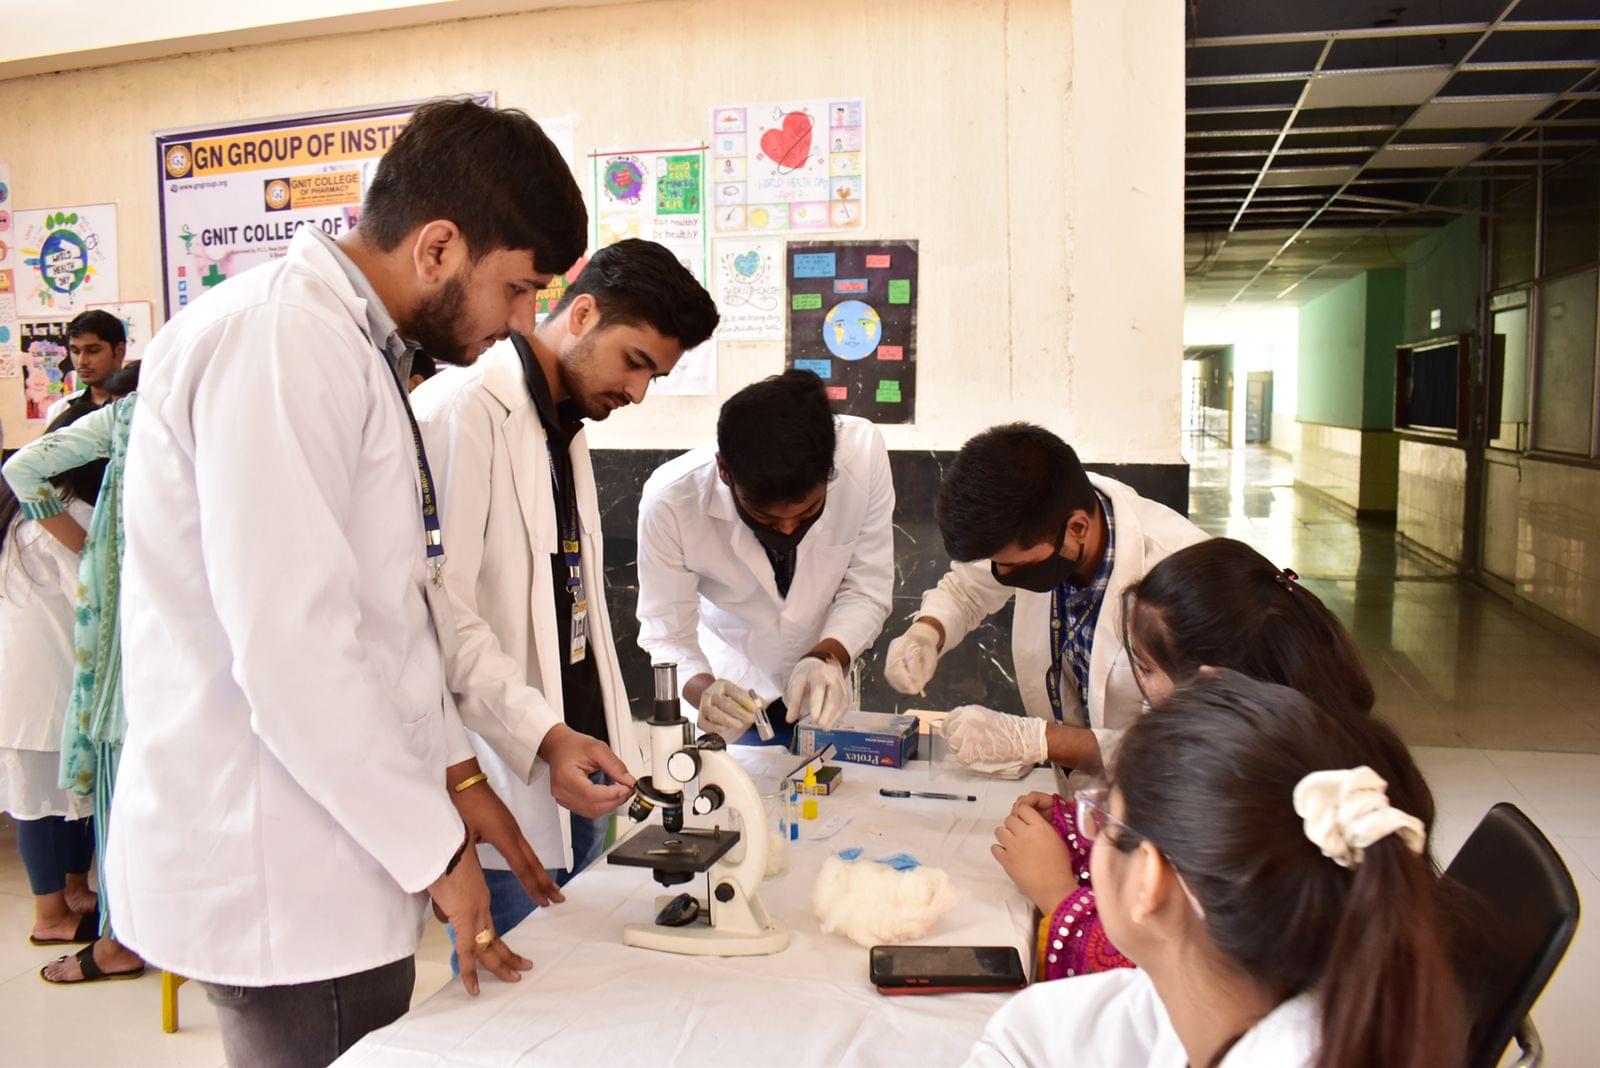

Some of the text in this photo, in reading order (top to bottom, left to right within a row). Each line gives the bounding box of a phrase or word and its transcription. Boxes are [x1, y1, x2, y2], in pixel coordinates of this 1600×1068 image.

[194, 144, 224, 170] GN
[227, 135, 303, 167] GROUP
[306, 132, 336, 158] OF
[291, 173, 359, 190] GNIT COLLEGE
[312, 185, 349, 195] PHARMACY
[201, 226, 239, 247] GNIT
[243, 219, 317, 243] COLLE
[321, 217, 343, 237] OF
